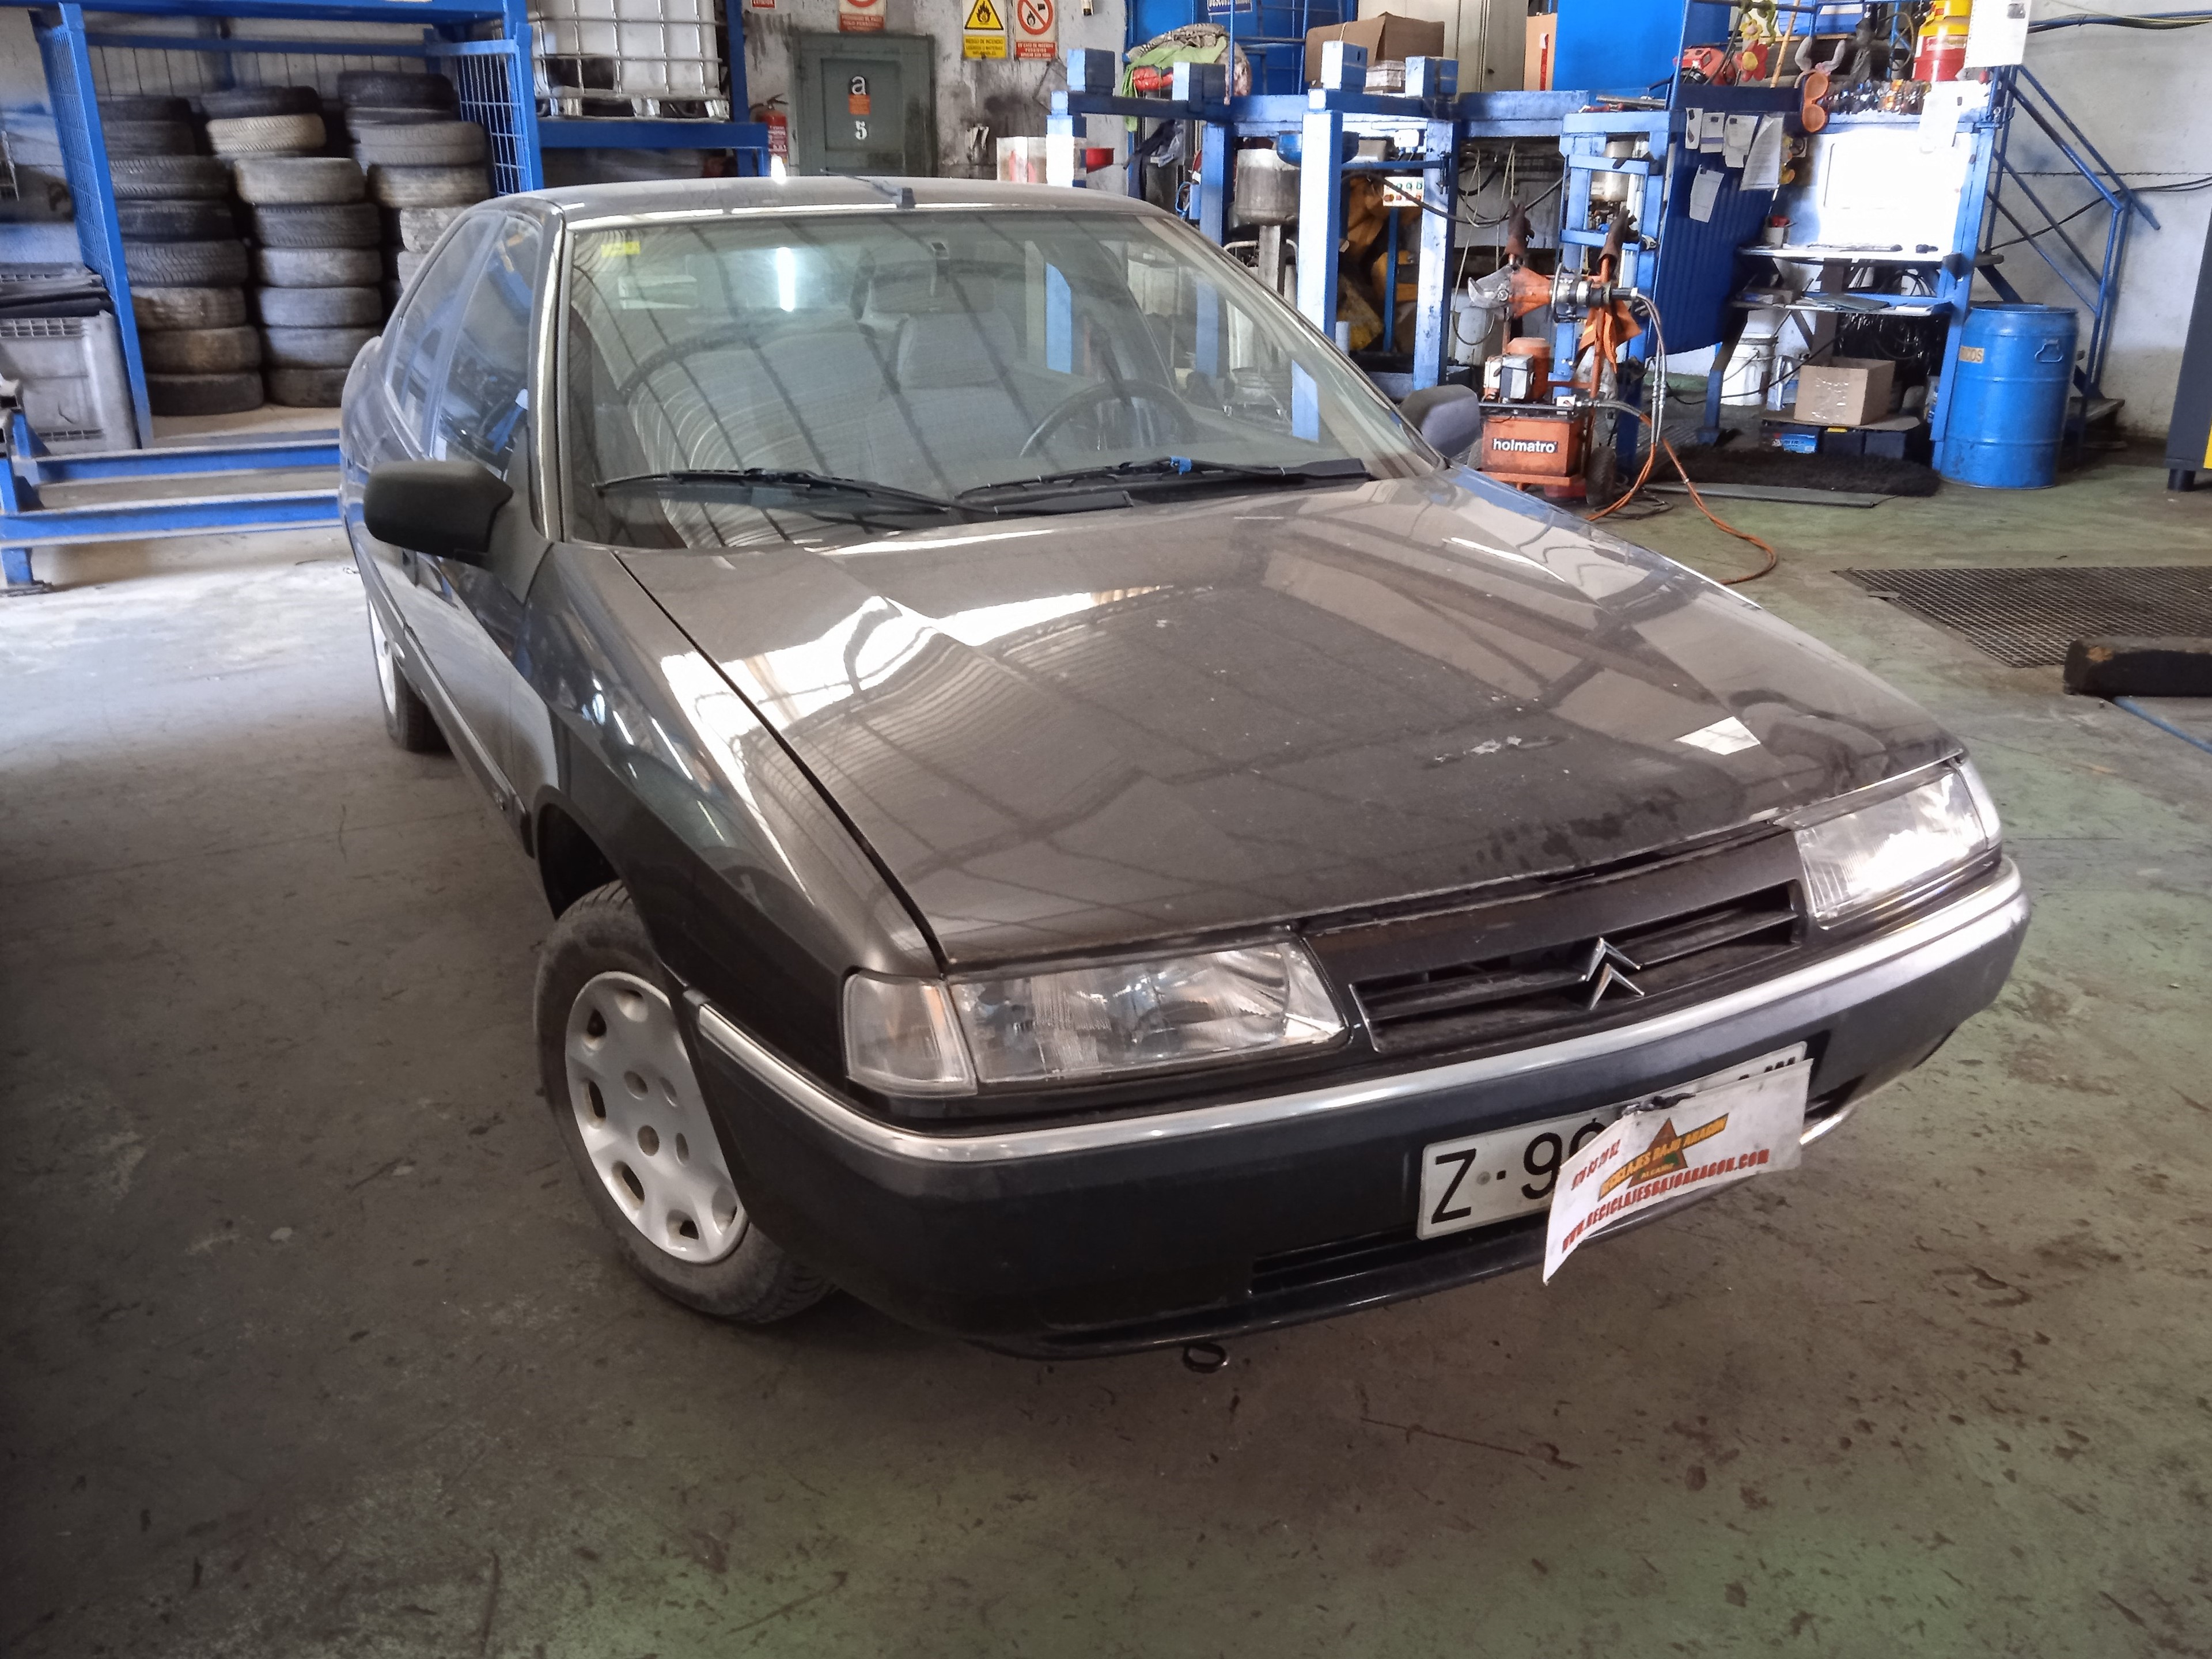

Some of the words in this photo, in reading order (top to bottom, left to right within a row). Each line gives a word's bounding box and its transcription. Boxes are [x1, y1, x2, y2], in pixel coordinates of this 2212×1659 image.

[852, 76, 866, 95] a
[855, 120, 868, 140] 5
[1493, 438, 1556, 453] holmatro
